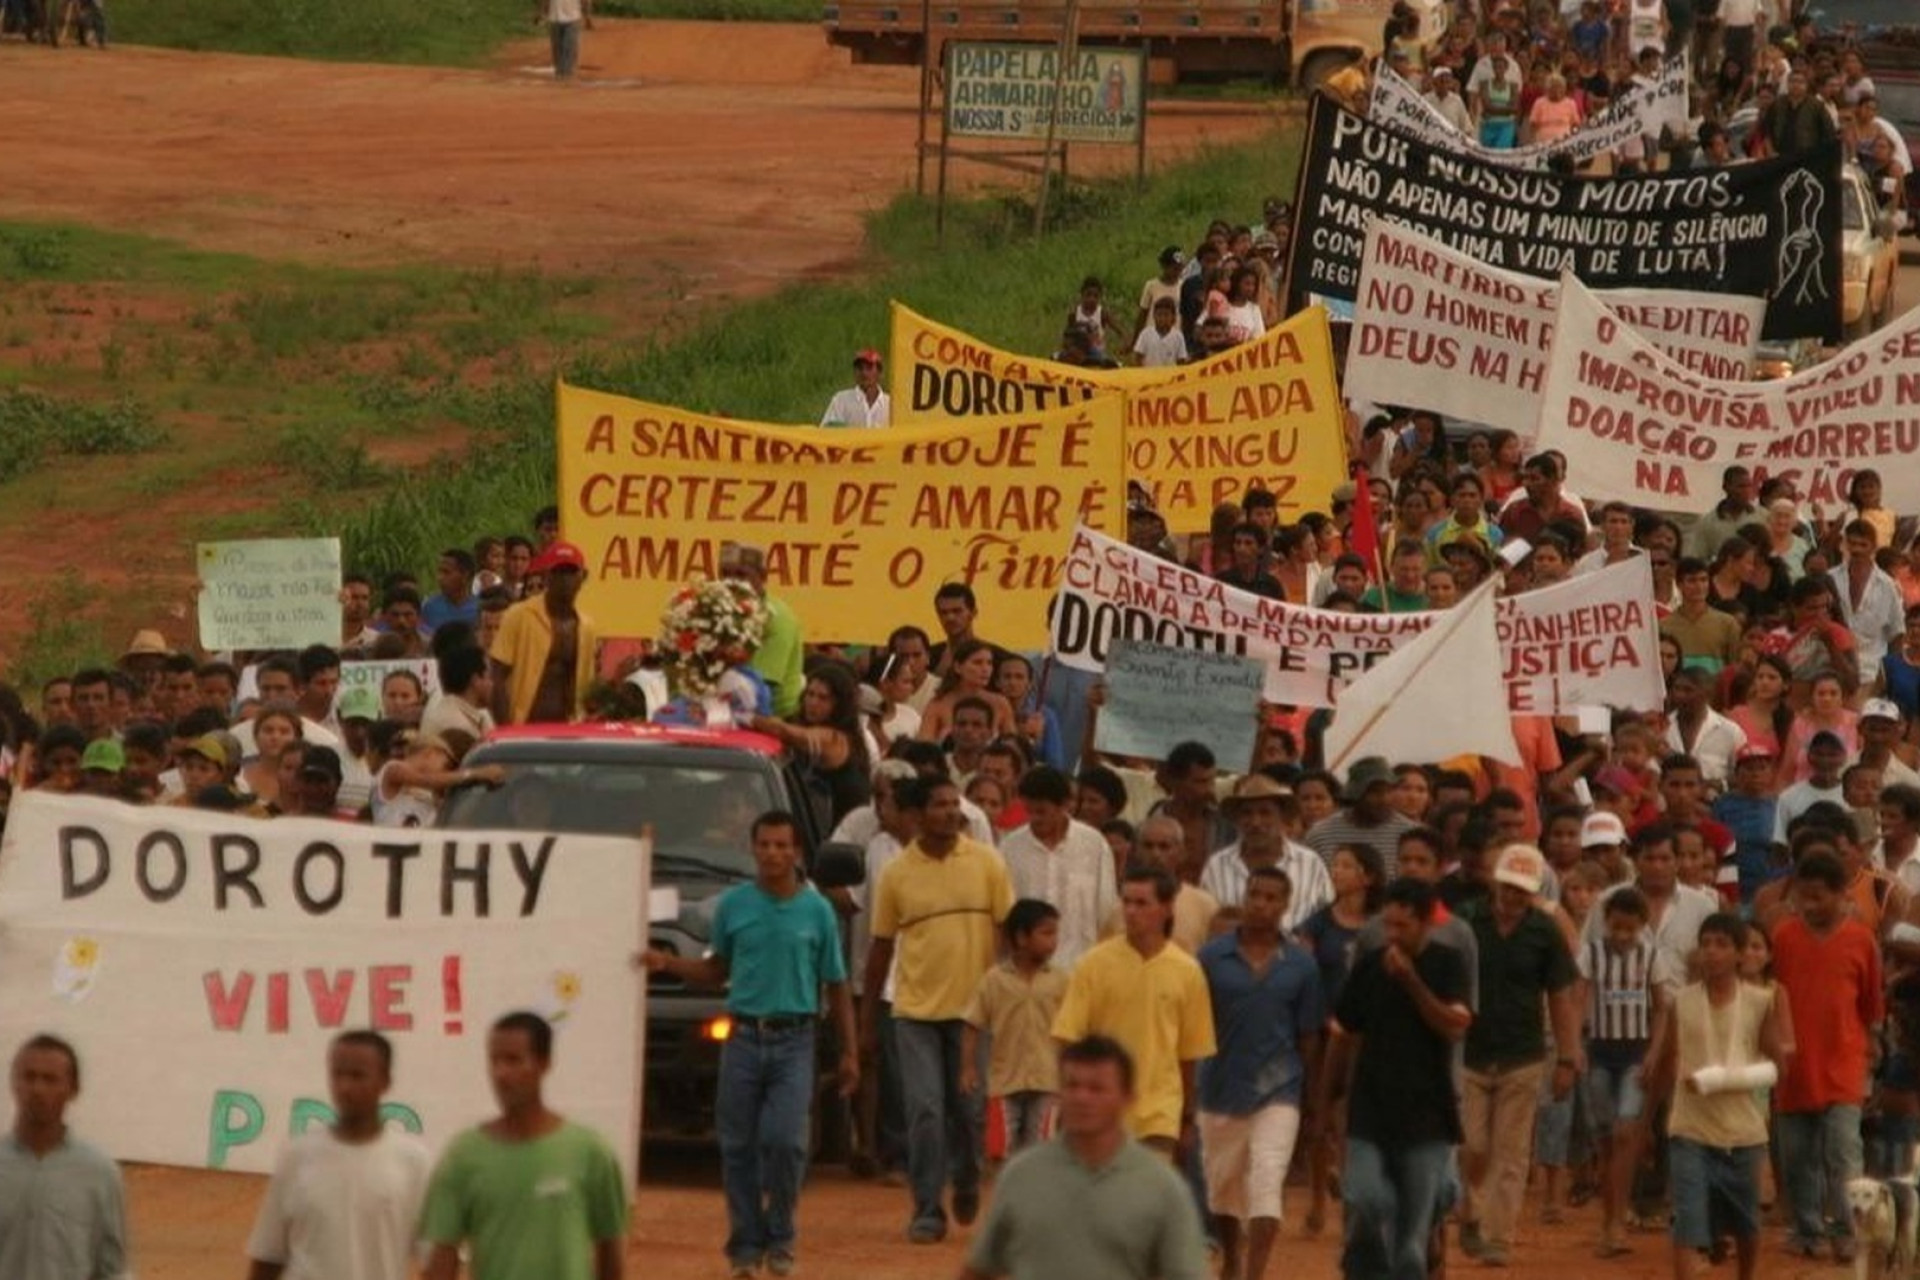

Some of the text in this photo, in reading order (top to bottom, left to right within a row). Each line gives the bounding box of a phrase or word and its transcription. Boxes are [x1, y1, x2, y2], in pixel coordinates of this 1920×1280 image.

[952, 108, 1005, 132] NOSSA
[953, 81, 1093, 110] ARMARINHO
[1325, 155, 1768, 247] NÃO APENAS UM MINUTO DE SILÊNCIO
[1578, 171, 1744, 212] MORTOS,
[1317, 193, 1375, 232] MAS
[1450, 232, 1504, 264] UMA
[1518, 241, 1576, 272] VIDA
[1590, 249, 1621, 275] DE
[1637, 242, 1727, 280] LUTA!
[1366, 278, 1414, 315] NO
[1424, 289, 1530, 346] HOMEM
[1375, 231, 1525, 305] MARTÍRIO
[1605, 303, 1751, 347] REDITAR
[911, 329, 994, 373] COM
[1004, 361, 1028, 381] A
[1358, 323, 1461, 369] DEUS
[1469, 344, 1510, 385] NA
[1596, 315, 1617, 345] O
[585, 414, 615, 454] A
[901, 423, 1043, 468] HOJE
[1060, 412, 1094, 468] É
[1165, 427, 1299, 471] XINGU
[1567, 395, 1717, 461] DOAÇÃO
[1763, 418, 1920, 460] MORREU
[579, 472, 809, 524] CERTEZA
[832, 481, 897, 526] DE
[909, 482, 1063, 532] AMAR
[1635, 458, 1690, 496] NA
[599, 534, 733, 583] AMA
[765, 529, 860, 588] ATÉ
[888, 545, 924, 589] O
[1070, 531, 1095, 557] A
[1066, 558, 1180, 620] CLAMA
[1190, 601, 1210, 628] A
[1353, 636, 1394, 650] DA
[1495, 600, 1645, 644] PANHEIRA
[1278, 645, 1307, 672] E
[58, 825, 558, 918] DOROTHY
